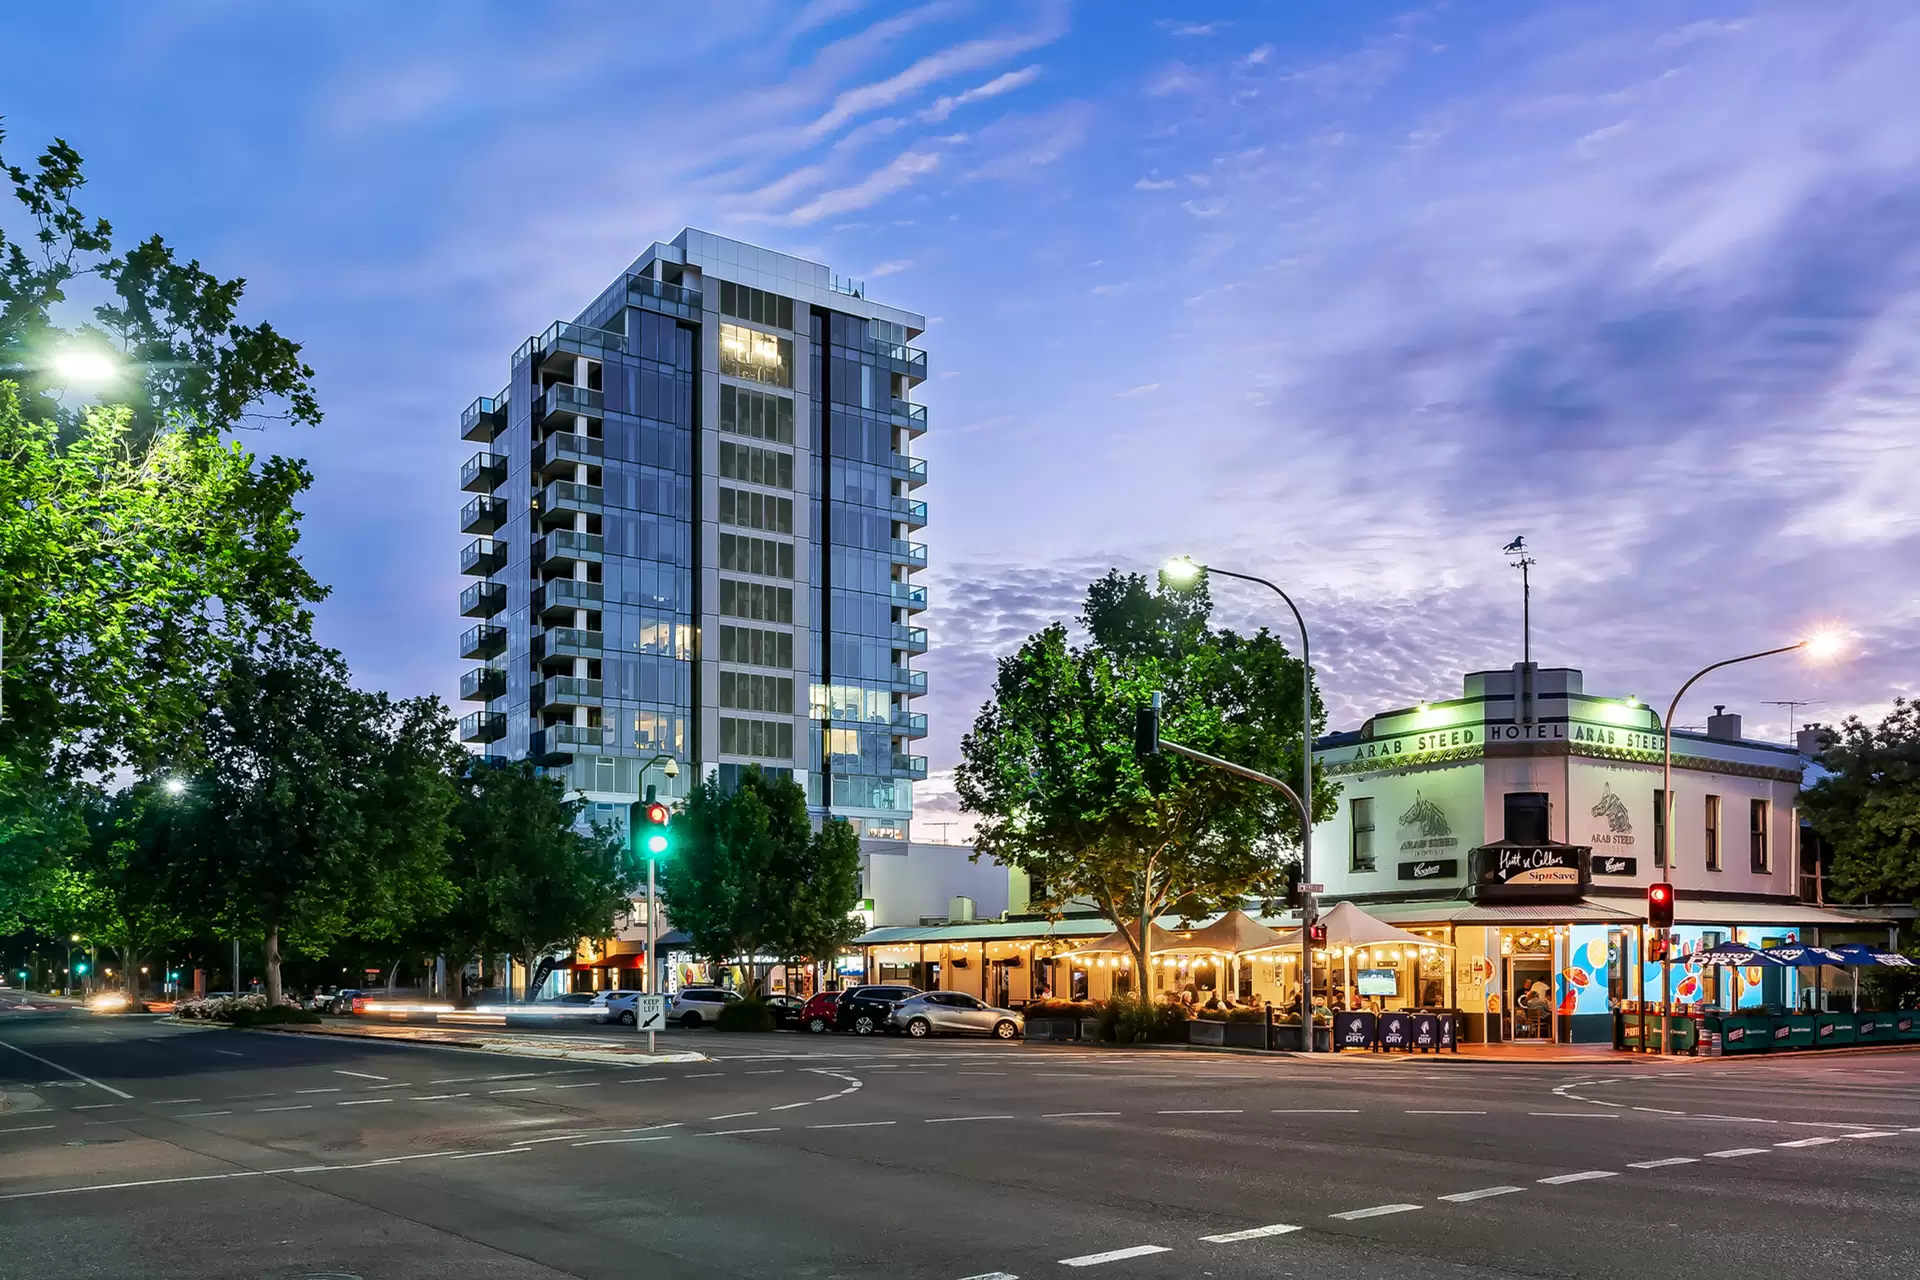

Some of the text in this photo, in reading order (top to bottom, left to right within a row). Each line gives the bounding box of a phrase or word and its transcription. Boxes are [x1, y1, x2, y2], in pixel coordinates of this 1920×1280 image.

[1491, 725, 1563, 740] HOTEL
[1575, 725, 1665, 750] ARAB STEED
[1354, 729, 1474, 760] ARAB STEED
[1591, 833, 1635, 845] ARAB STEED
[1691, 951, 1755, 959] CARLTON
[1687, 957, 1751, 966] DRY
[643, 998, 660, 1006] KEEP
[643, 1005, 659, 1013] LEFT
[1345, 1035, 1365, 1043] DRY
[1418, 1036, 1432, 1044] DRY
